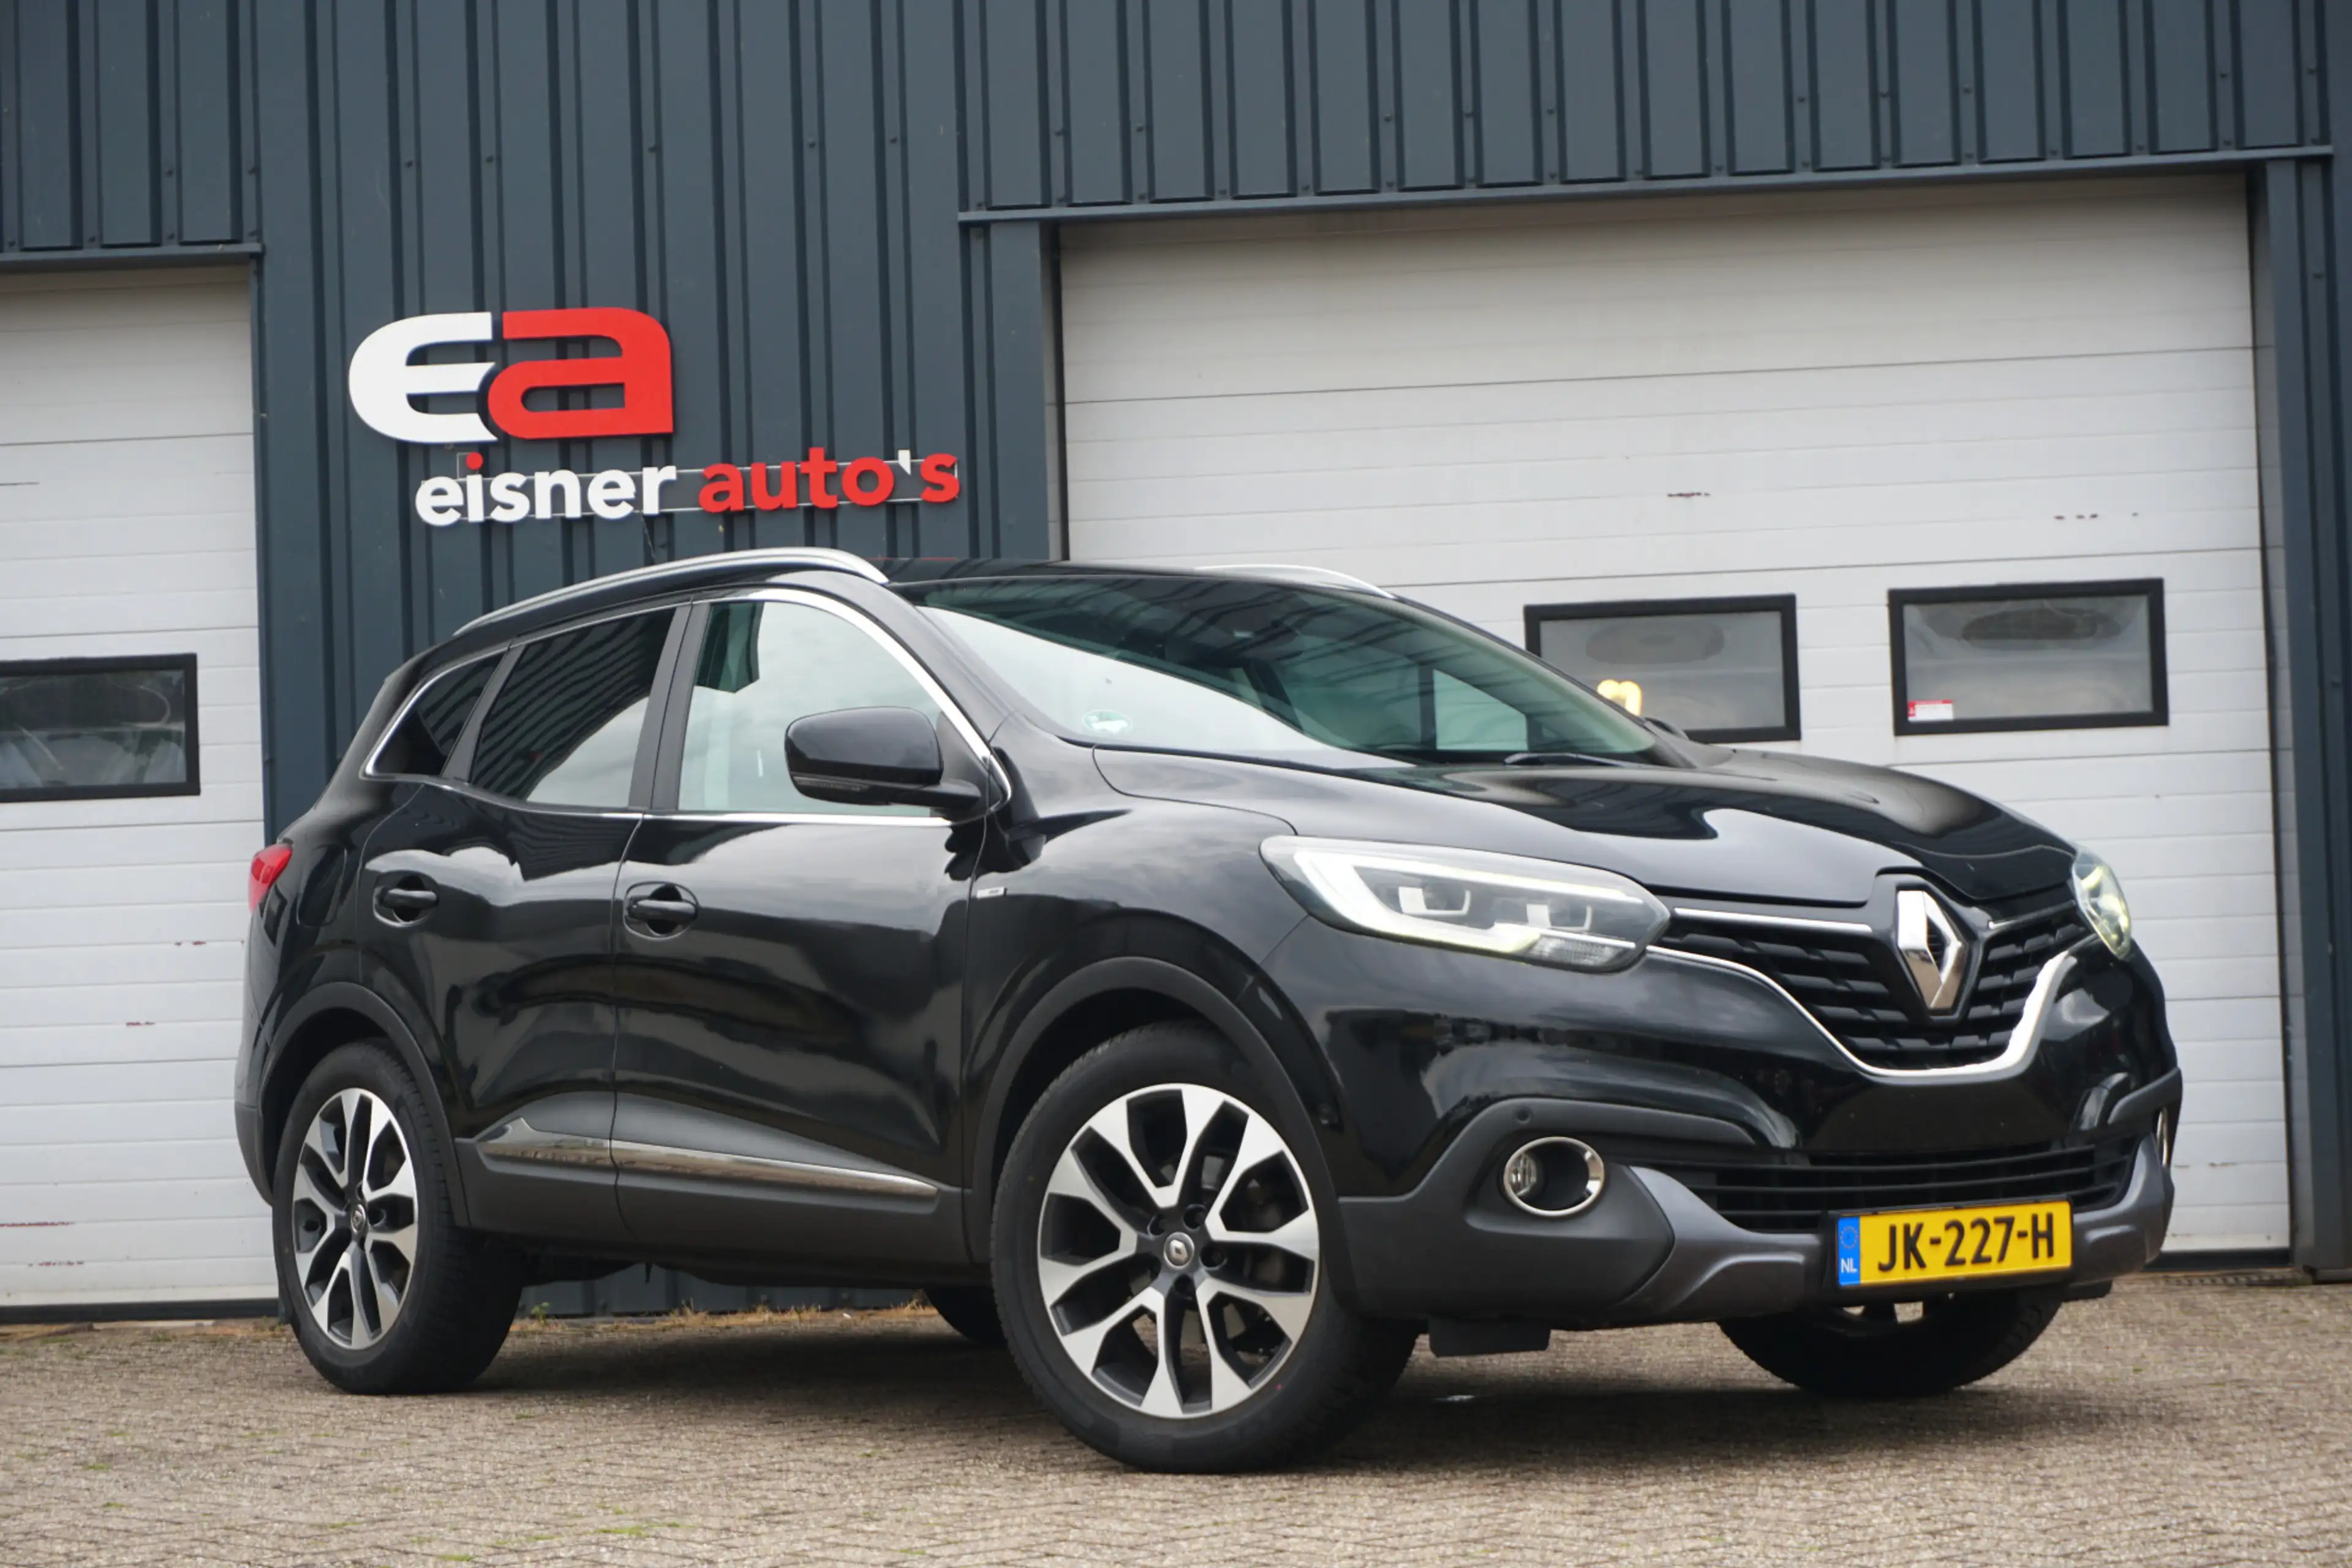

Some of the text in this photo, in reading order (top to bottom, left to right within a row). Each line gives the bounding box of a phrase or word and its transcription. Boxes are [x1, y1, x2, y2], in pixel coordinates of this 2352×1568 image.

[415, 447, 960, 527] eisner auto's
[1841, 1257, 1857, 1274] NL
[1877, 1211, 2054, 1273] JK-227-H
